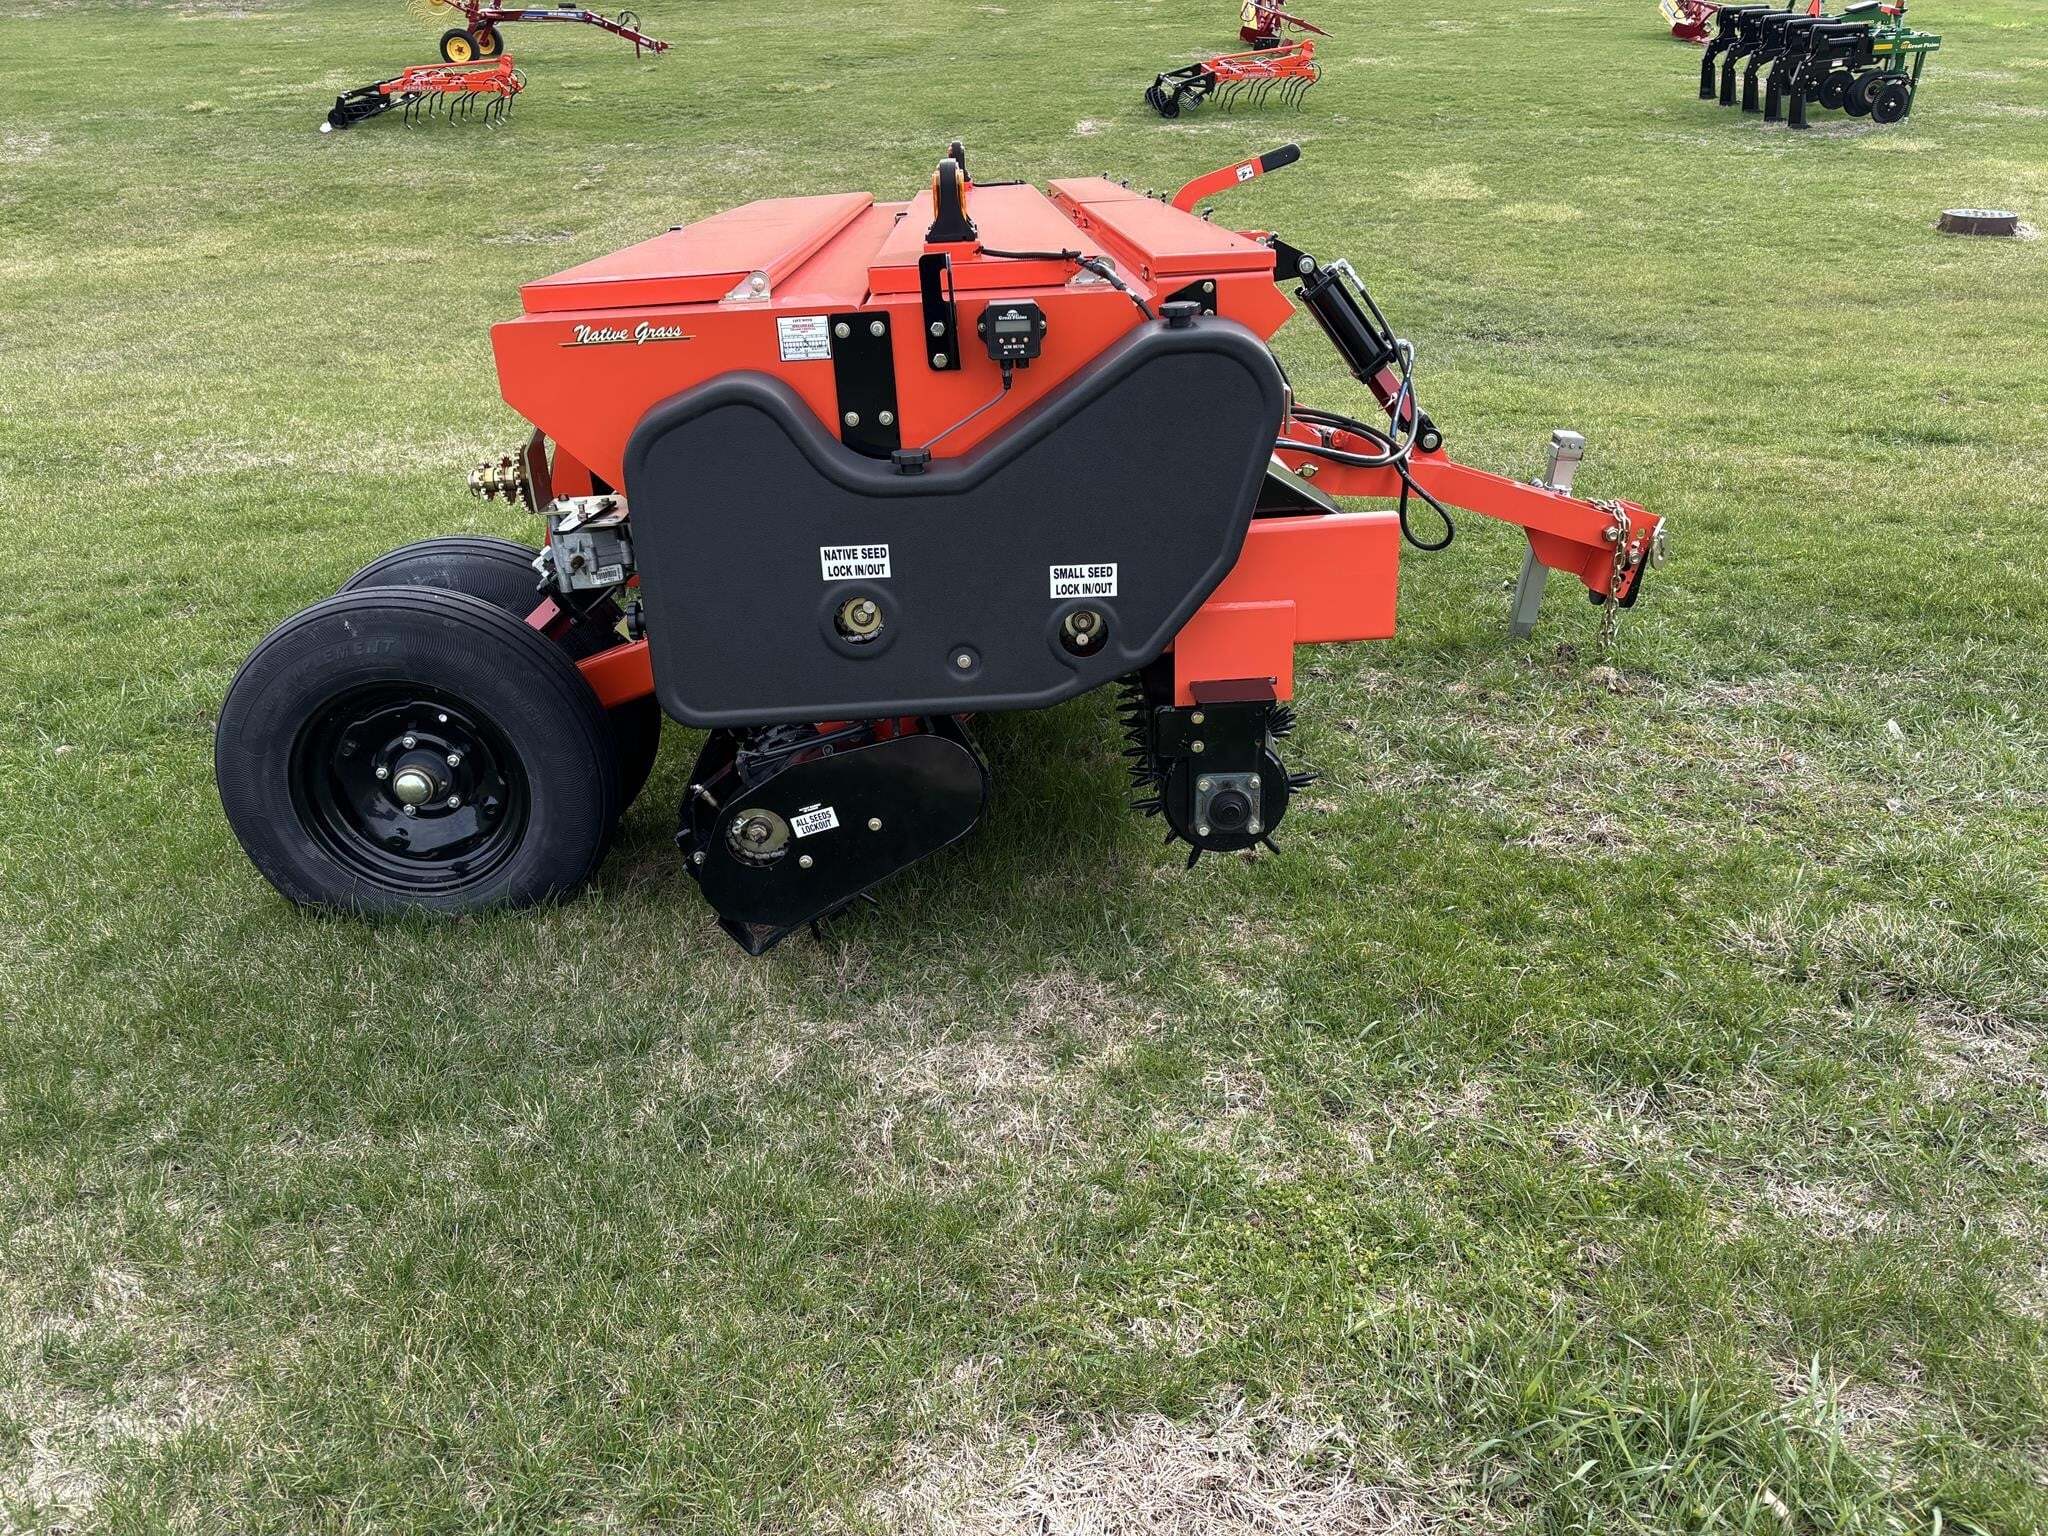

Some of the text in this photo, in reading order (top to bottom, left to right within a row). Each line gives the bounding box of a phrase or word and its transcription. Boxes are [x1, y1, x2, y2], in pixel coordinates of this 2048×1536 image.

[573, 321, 683, 346] Native Grass
[823, 547, 887, 561] NATIVE SEED
[827, 563, 886, 577] LOCK IN/OUT
[1053, 566, 1113, 579] SMALL SEED
[1055, 582, 1113, 596] LOCK IN/OUT
[796, 810, 832, 827] ALL SEEDS
[801, 820, 832, 834] LOCKOUT
